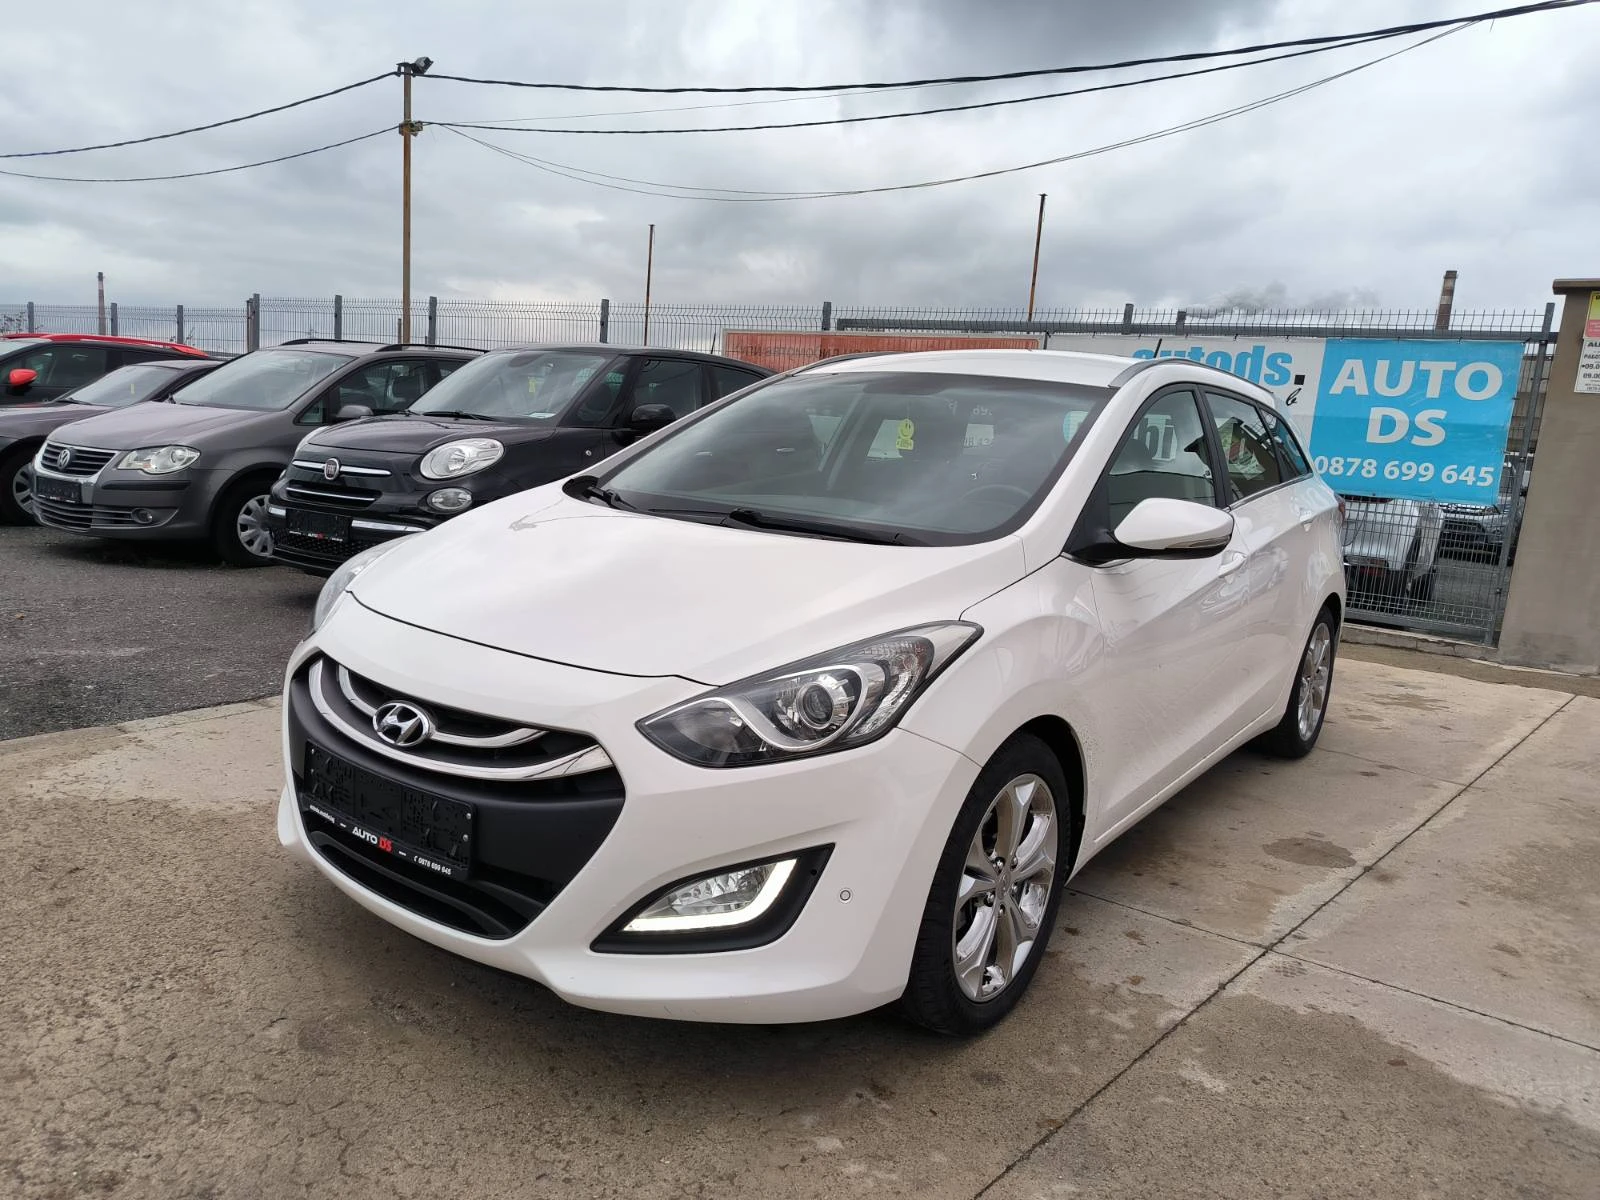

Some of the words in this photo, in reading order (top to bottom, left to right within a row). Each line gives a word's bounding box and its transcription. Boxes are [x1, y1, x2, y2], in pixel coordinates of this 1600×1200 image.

[1329, 359, 1504, 401] AUTO
[1366, 407, 1448, 447] DS
[1314, 455, 1378, 478] 0878
[1383, 460, 1435, 482] 699
[1441, 464, 1494, 487] 645
[352, 826, 378, 845] AUTO
[379, 837, 393, 852] DS
